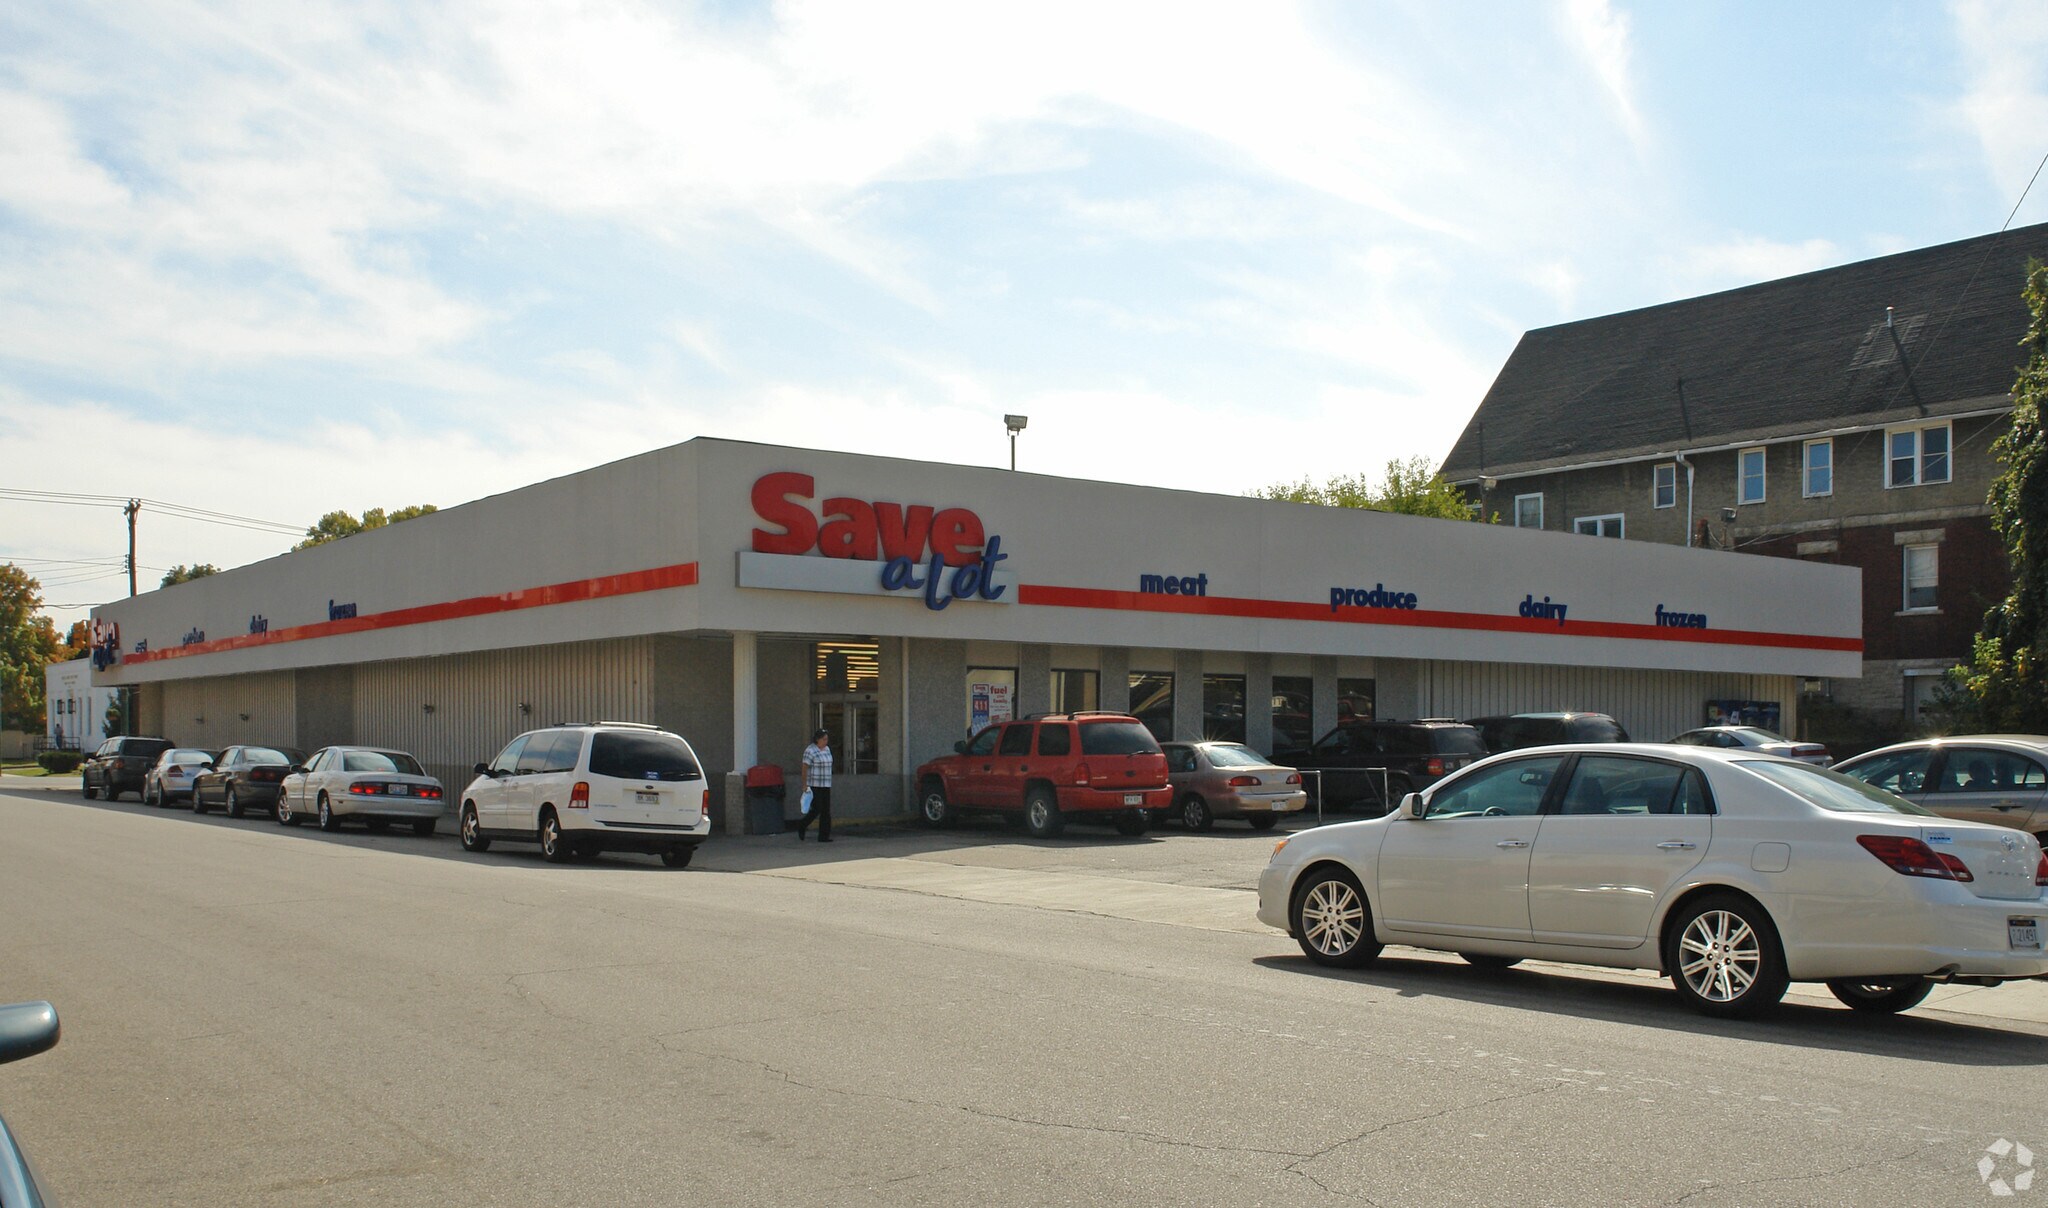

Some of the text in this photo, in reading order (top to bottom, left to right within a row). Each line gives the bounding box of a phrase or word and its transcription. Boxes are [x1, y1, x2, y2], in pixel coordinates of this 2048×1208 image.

[751, 471, 985, 567] Save
[1140, 573, 1208, 597] meat
[1330, 583, 1417, 612] produce
[1519, 595, 1568, 627] dairy
[1655, 604, 1707, 629] frozen
